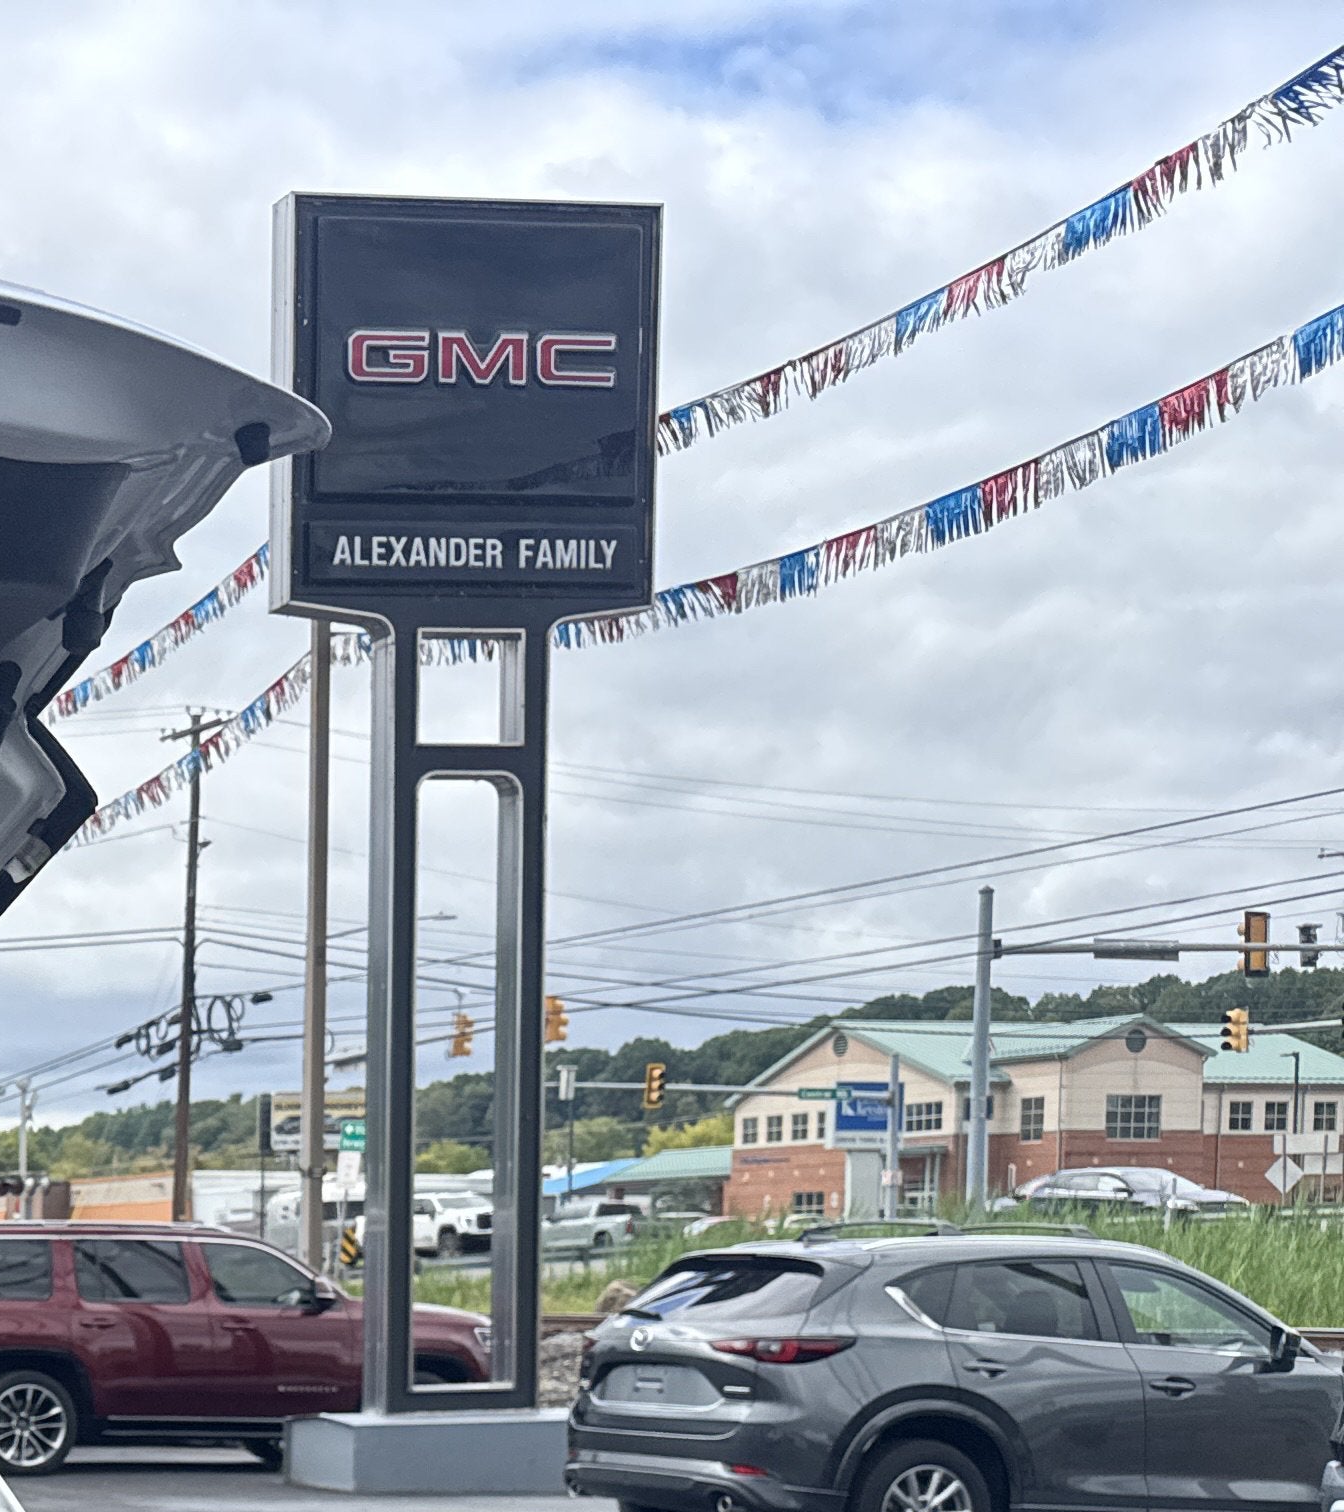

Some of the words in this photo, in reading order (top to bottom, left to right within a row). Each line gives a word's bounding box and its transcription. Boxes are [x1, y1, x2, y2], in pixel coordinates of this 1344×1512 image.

[348, 330, 616, 387] GMC
[332, 536, 504, 568] ALEXANDER
[518, 538, 618, 569] FAMILY
